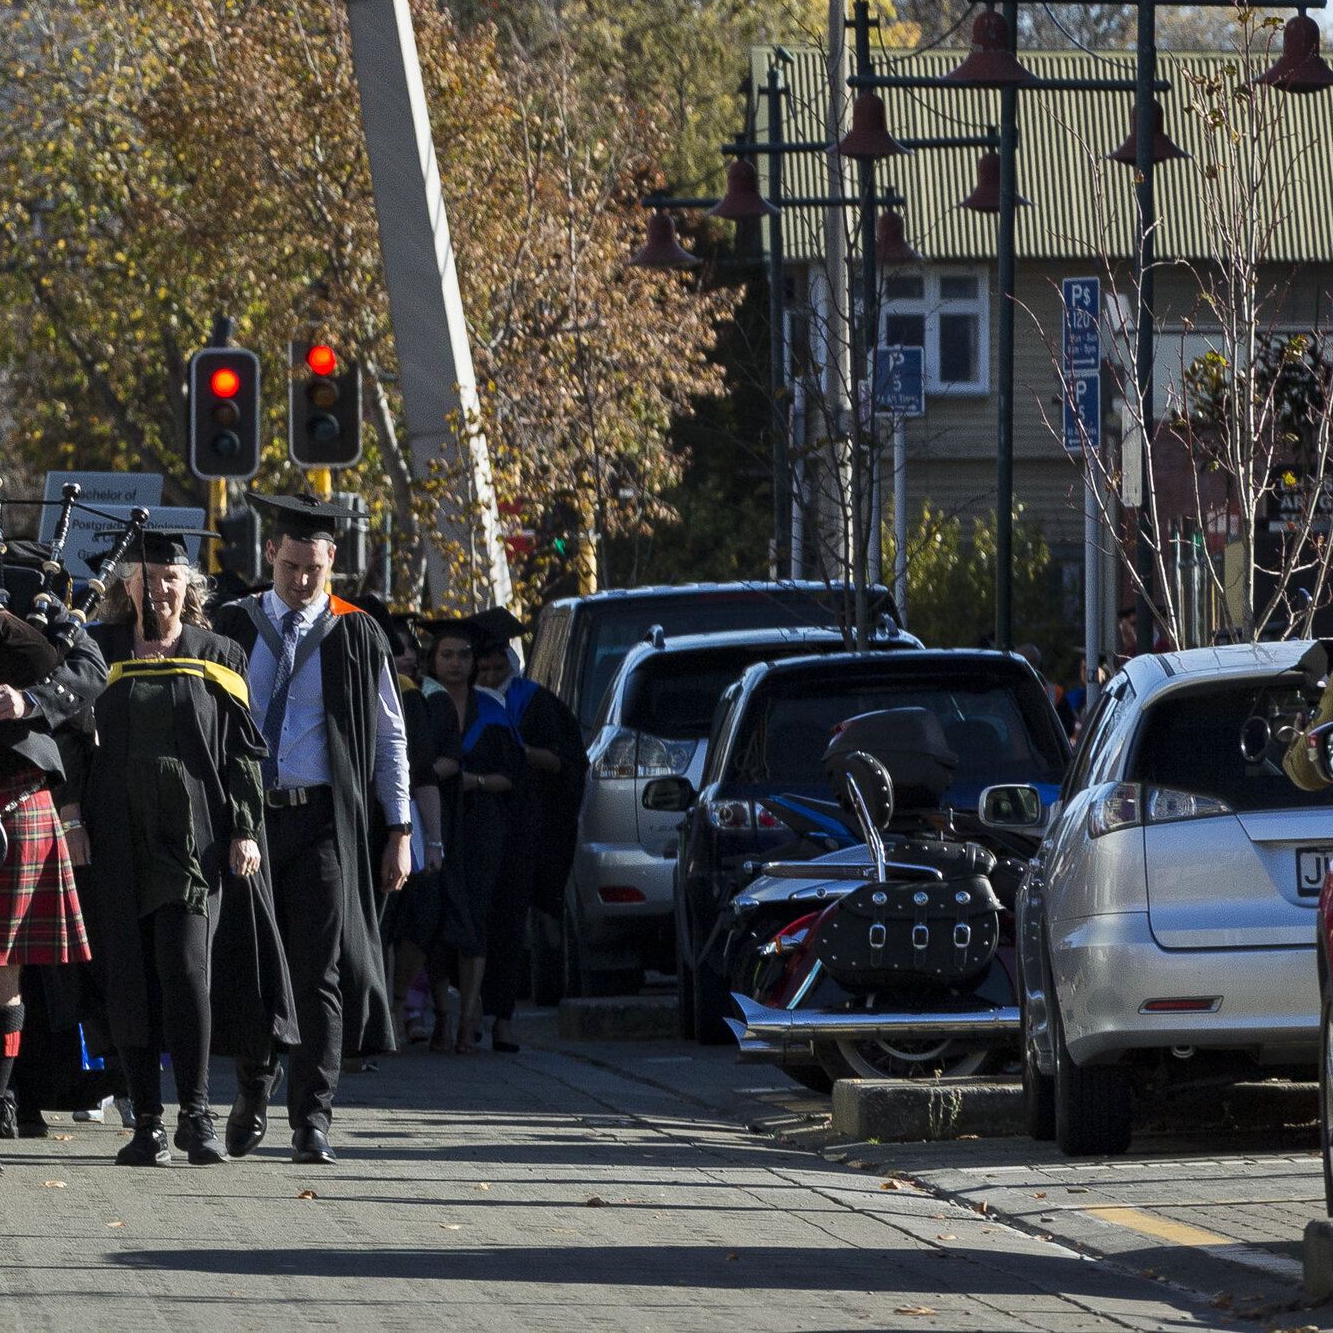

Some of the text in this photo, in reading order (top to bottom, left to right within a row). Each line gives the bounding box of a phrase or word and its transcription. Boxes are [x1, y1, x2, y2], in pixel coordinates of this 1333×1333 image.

[1073, 312, 1090, 329] 120
[1075, 381, 1087, 403] P
[80, 489, 137, 501] achelor of
